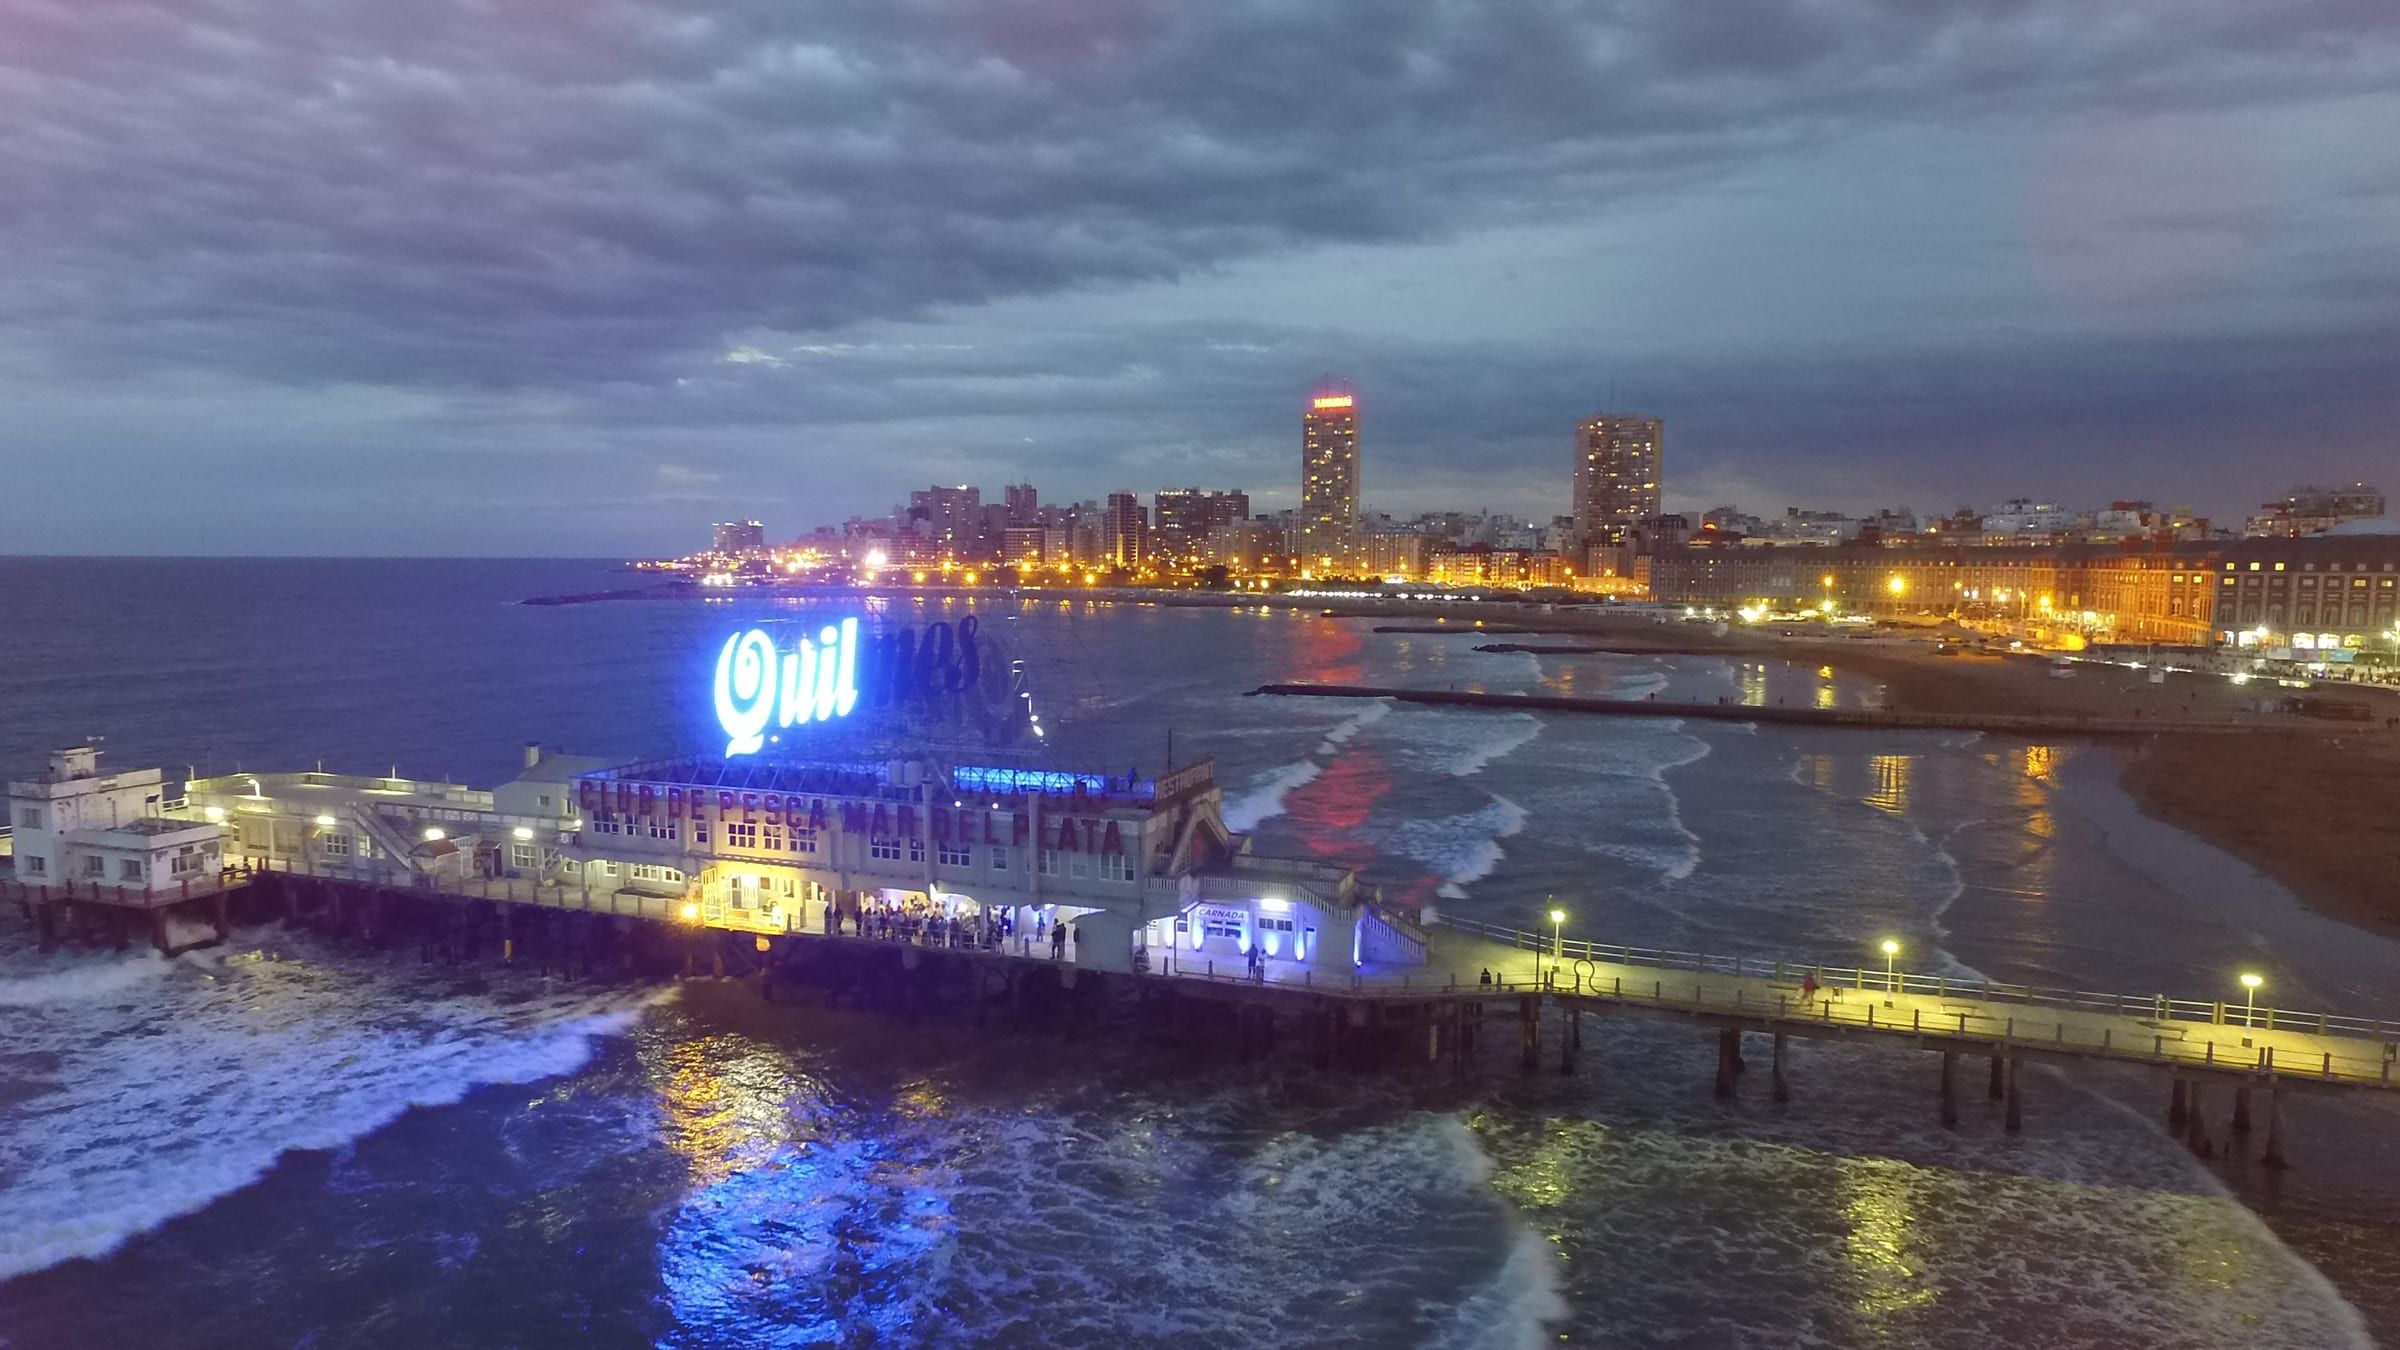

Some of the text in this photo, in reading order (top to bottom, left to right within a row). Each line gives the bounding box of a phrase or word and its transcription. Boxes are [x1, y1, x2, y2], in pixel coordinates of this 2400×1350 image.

[579, 780, 1124, 857] CLUB DE PESCA MAR DEL PLATA
[1198, 908, 1245, 920] CARNADA
